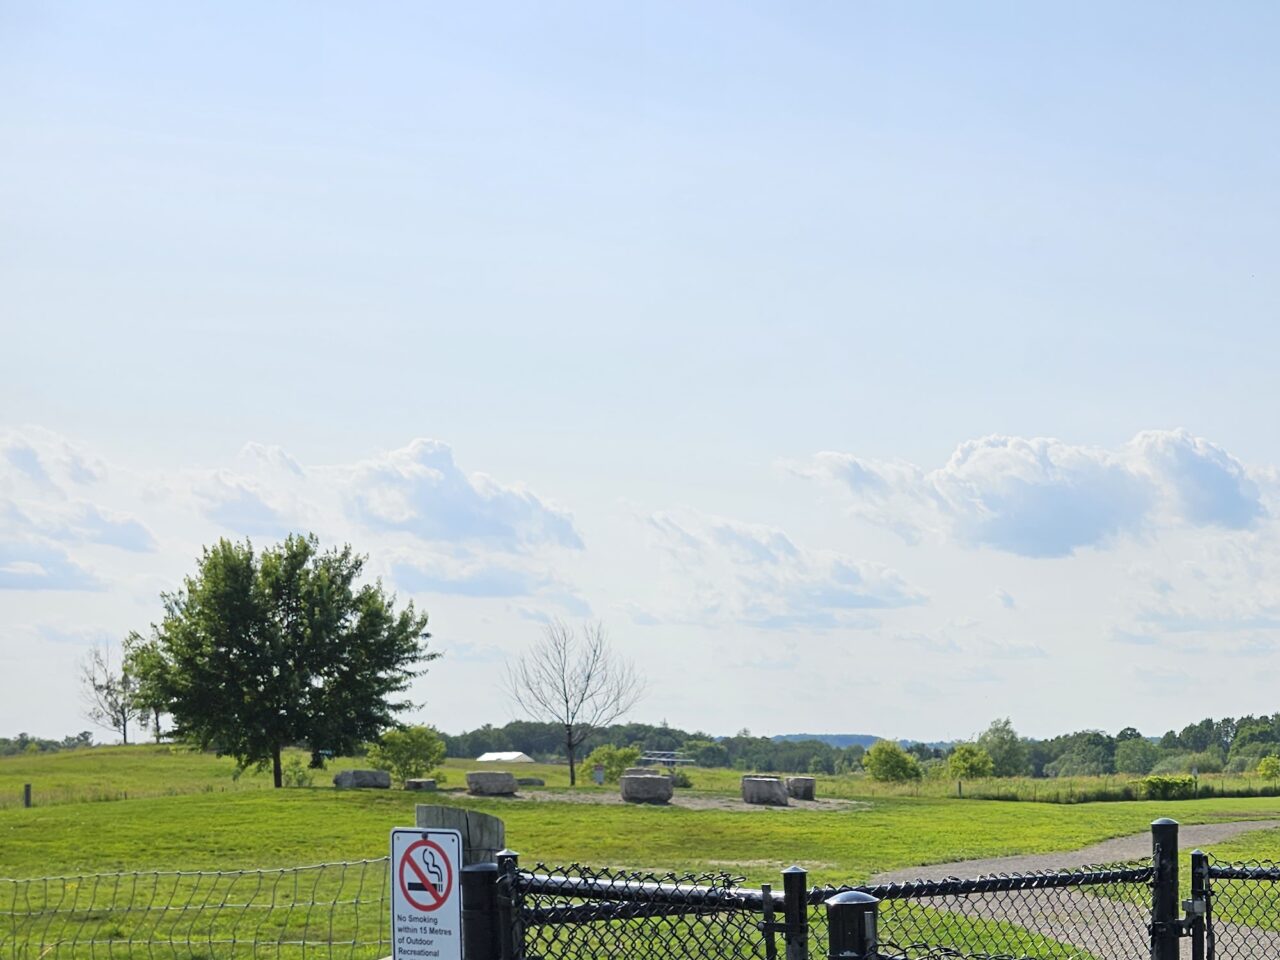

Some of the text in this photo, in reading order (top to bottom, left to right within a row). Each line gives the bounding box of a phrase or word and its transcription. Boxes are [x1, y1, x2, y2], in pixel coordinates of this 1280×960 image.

[397, 914, 438, 926] No Smoking
[397, 926, 452, 936] within 15 Metres
[397, 936, 434, 945] of Outdoor
[398, 946, 440, 957] Recreational
